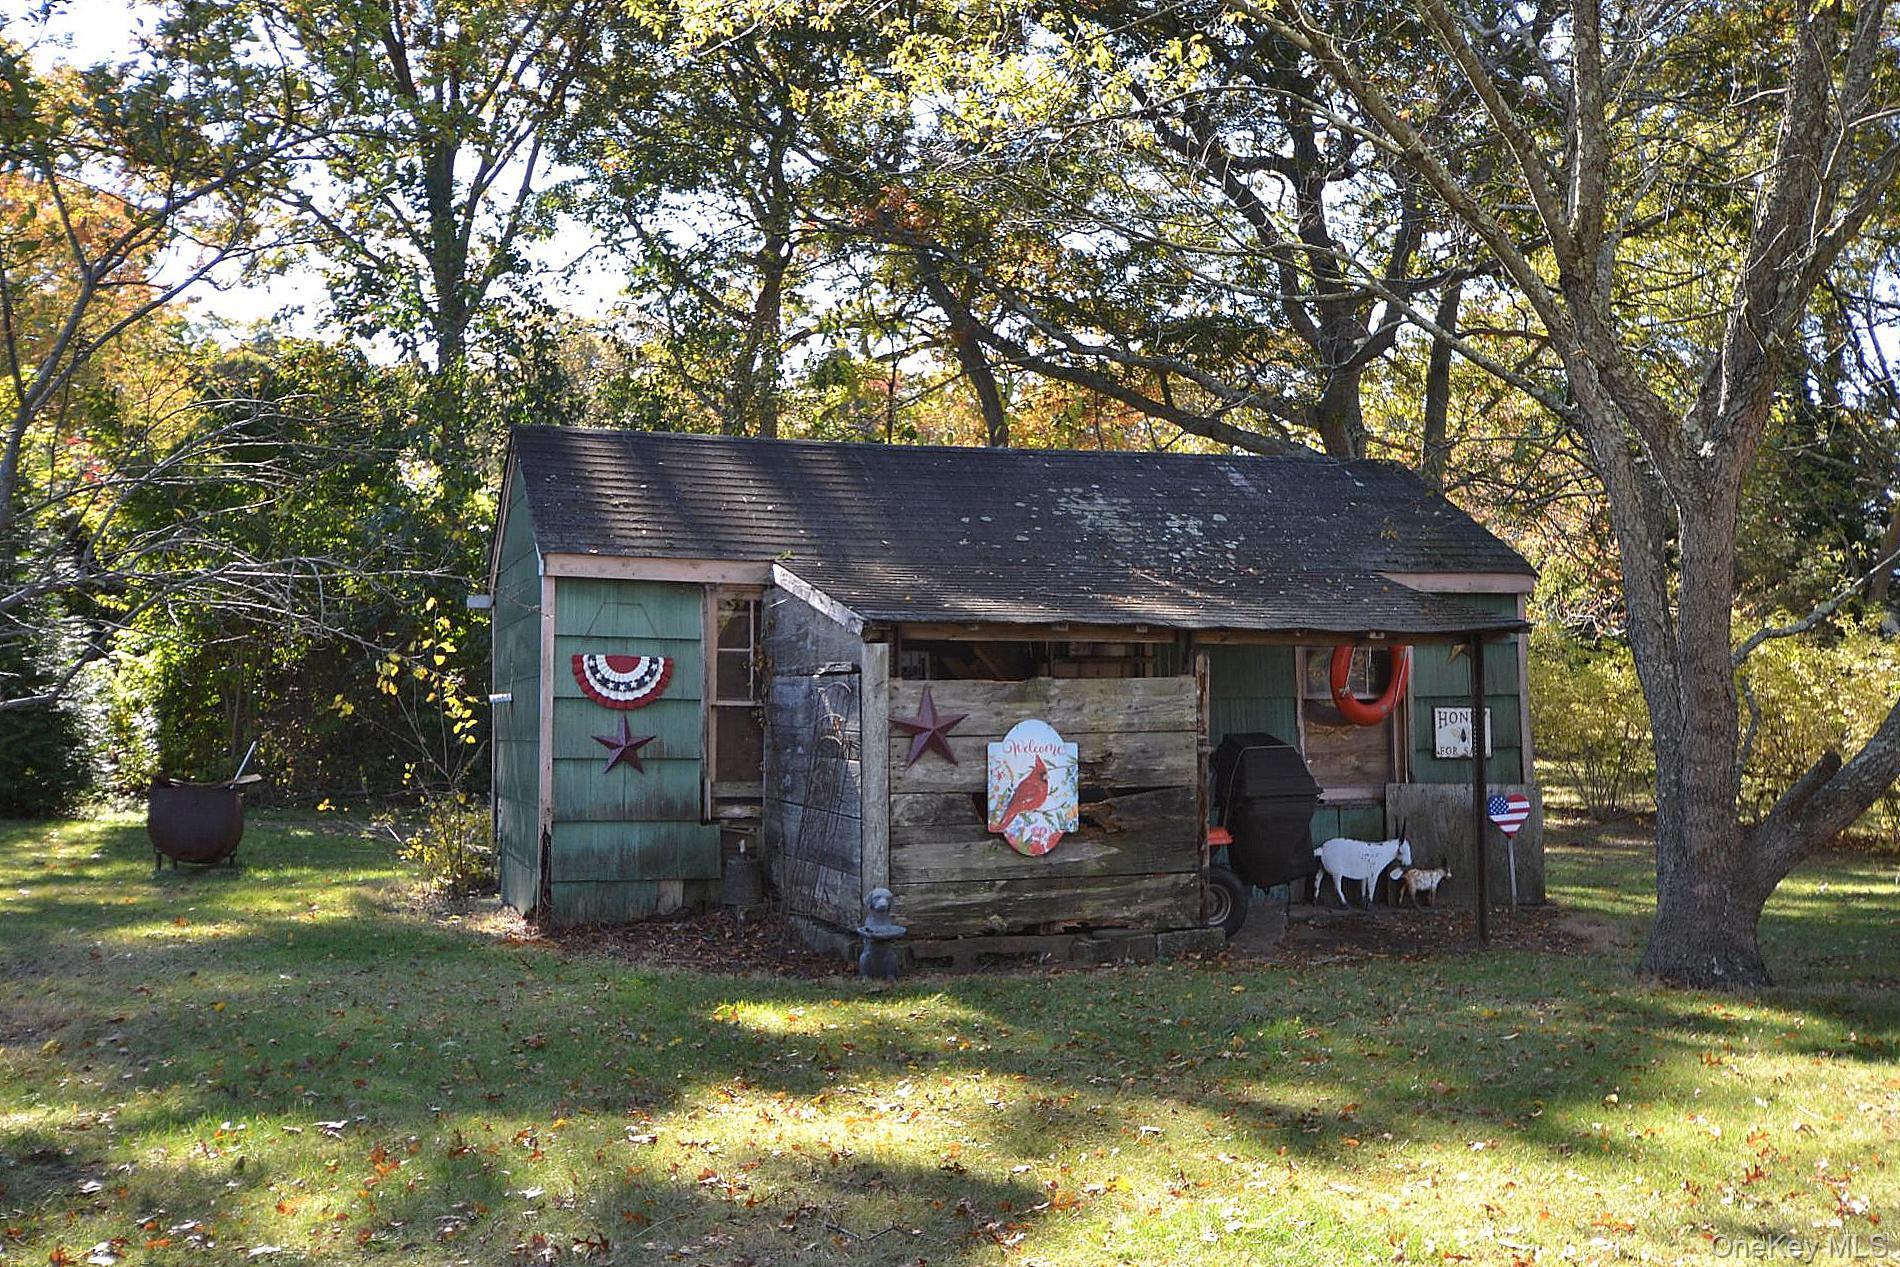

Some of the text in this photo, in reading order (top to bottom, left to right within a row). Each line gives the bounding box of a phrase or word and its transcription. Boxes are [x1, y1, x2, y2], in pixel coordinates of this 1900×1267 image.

[1438, 711, 1474, 729] HON
[1003, 738, 1066, 756] Welcome
[1440, 746, 1458, 755] FOR
